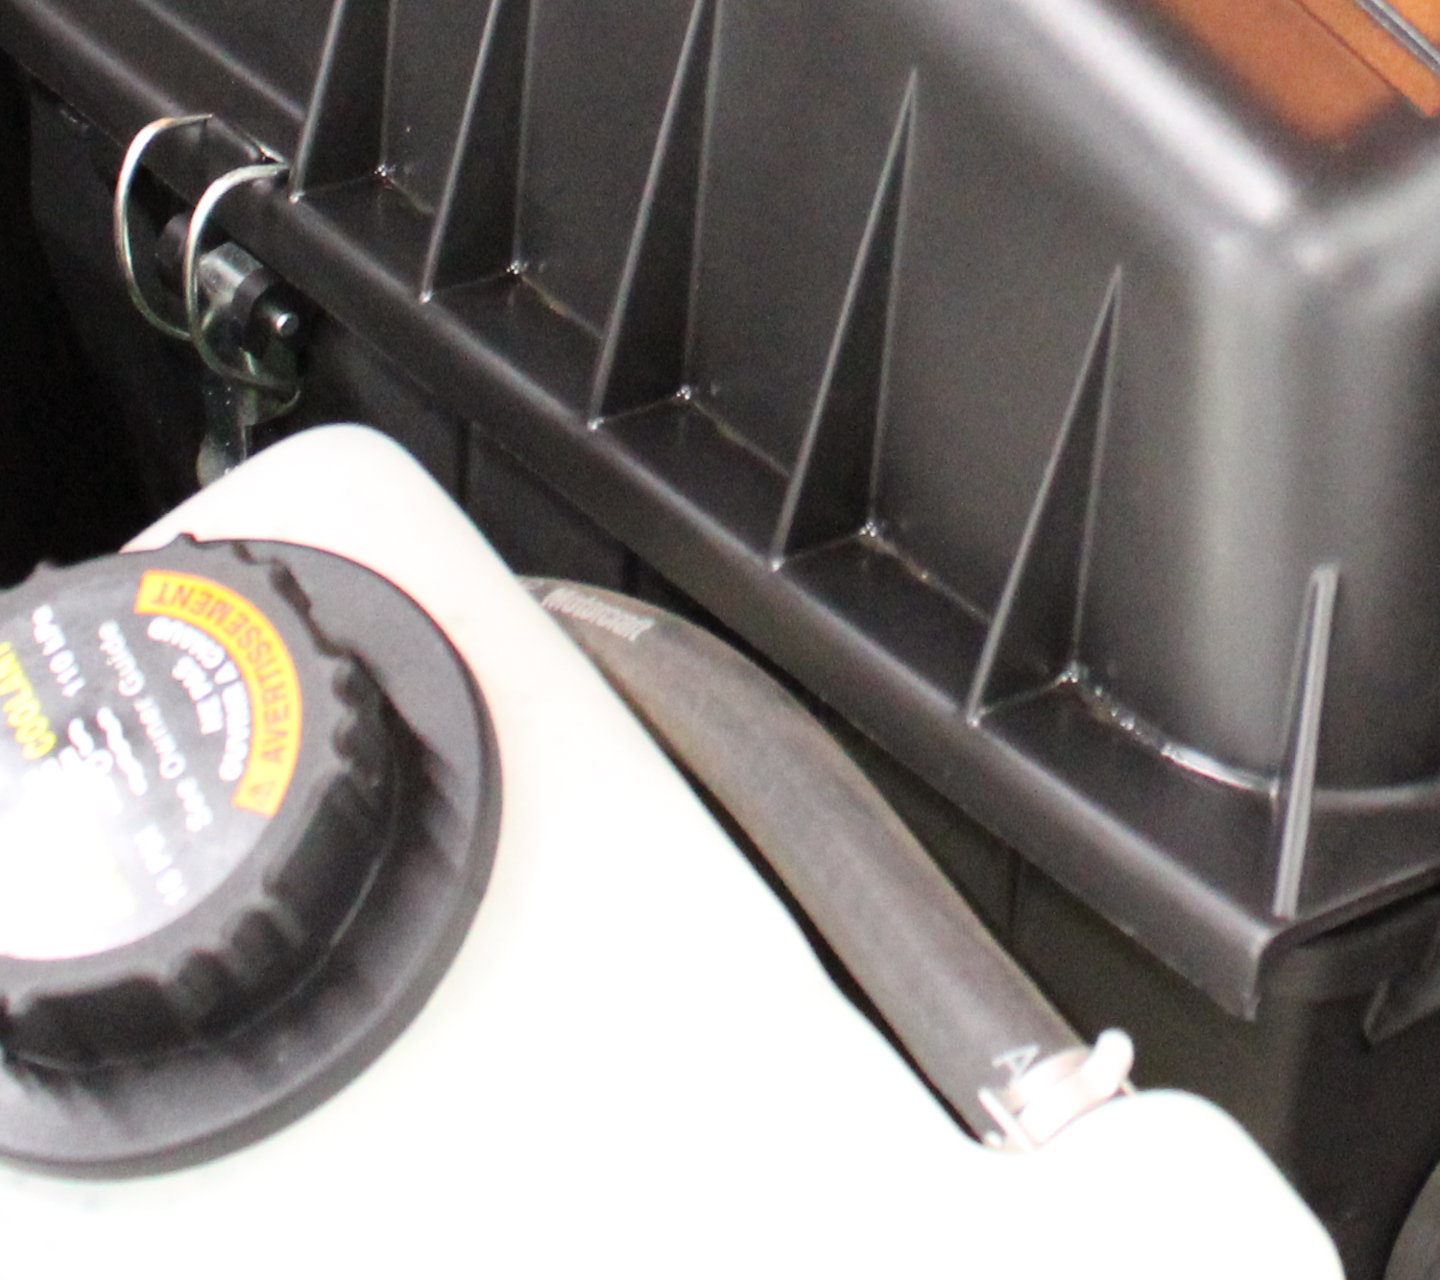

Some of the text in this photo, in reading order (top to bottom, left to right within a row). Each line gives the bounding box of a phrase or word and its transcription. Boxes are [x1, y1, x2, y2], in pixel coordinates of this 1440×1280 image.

[98, 618, 214, 833] See Owner Guide
[151, 580, 292, 766] AVERTISSEMENT
